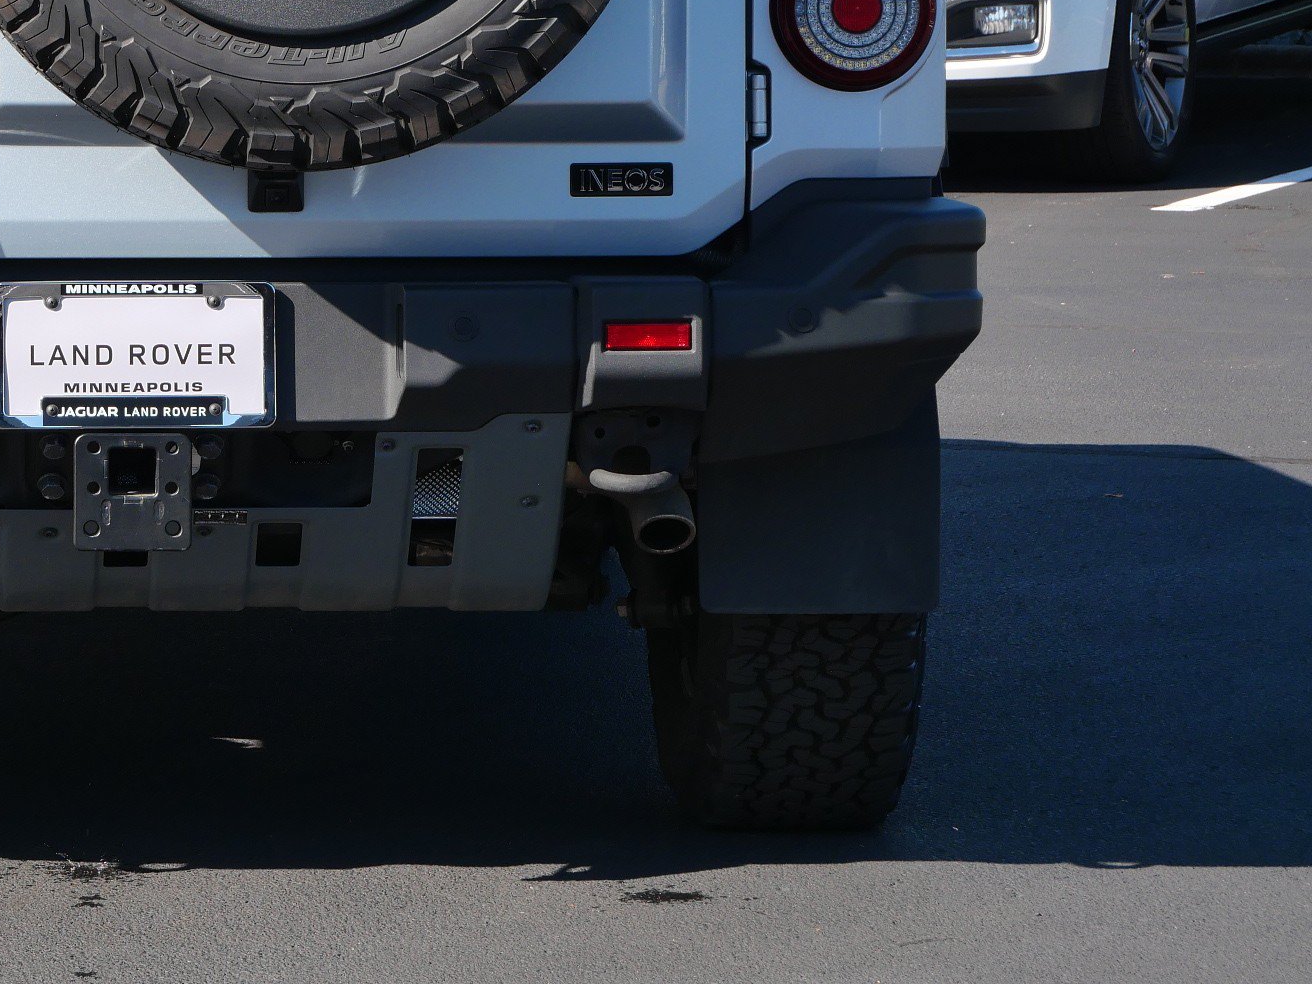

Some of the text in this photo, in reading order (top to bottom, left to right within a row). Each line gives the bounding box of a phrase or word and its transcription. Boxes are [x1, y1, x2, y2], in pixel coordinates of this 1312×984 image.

[579, 168, 665, 192] INEOS
[65, 283, 197, 294] MINNEAPOLIS
[30, 343, 237, 366] LAND ROVER
[63, 381, 203, 393] MINNEAPOLIS
[57, 406, 207, 417] JAGUAR LAND ROVER
